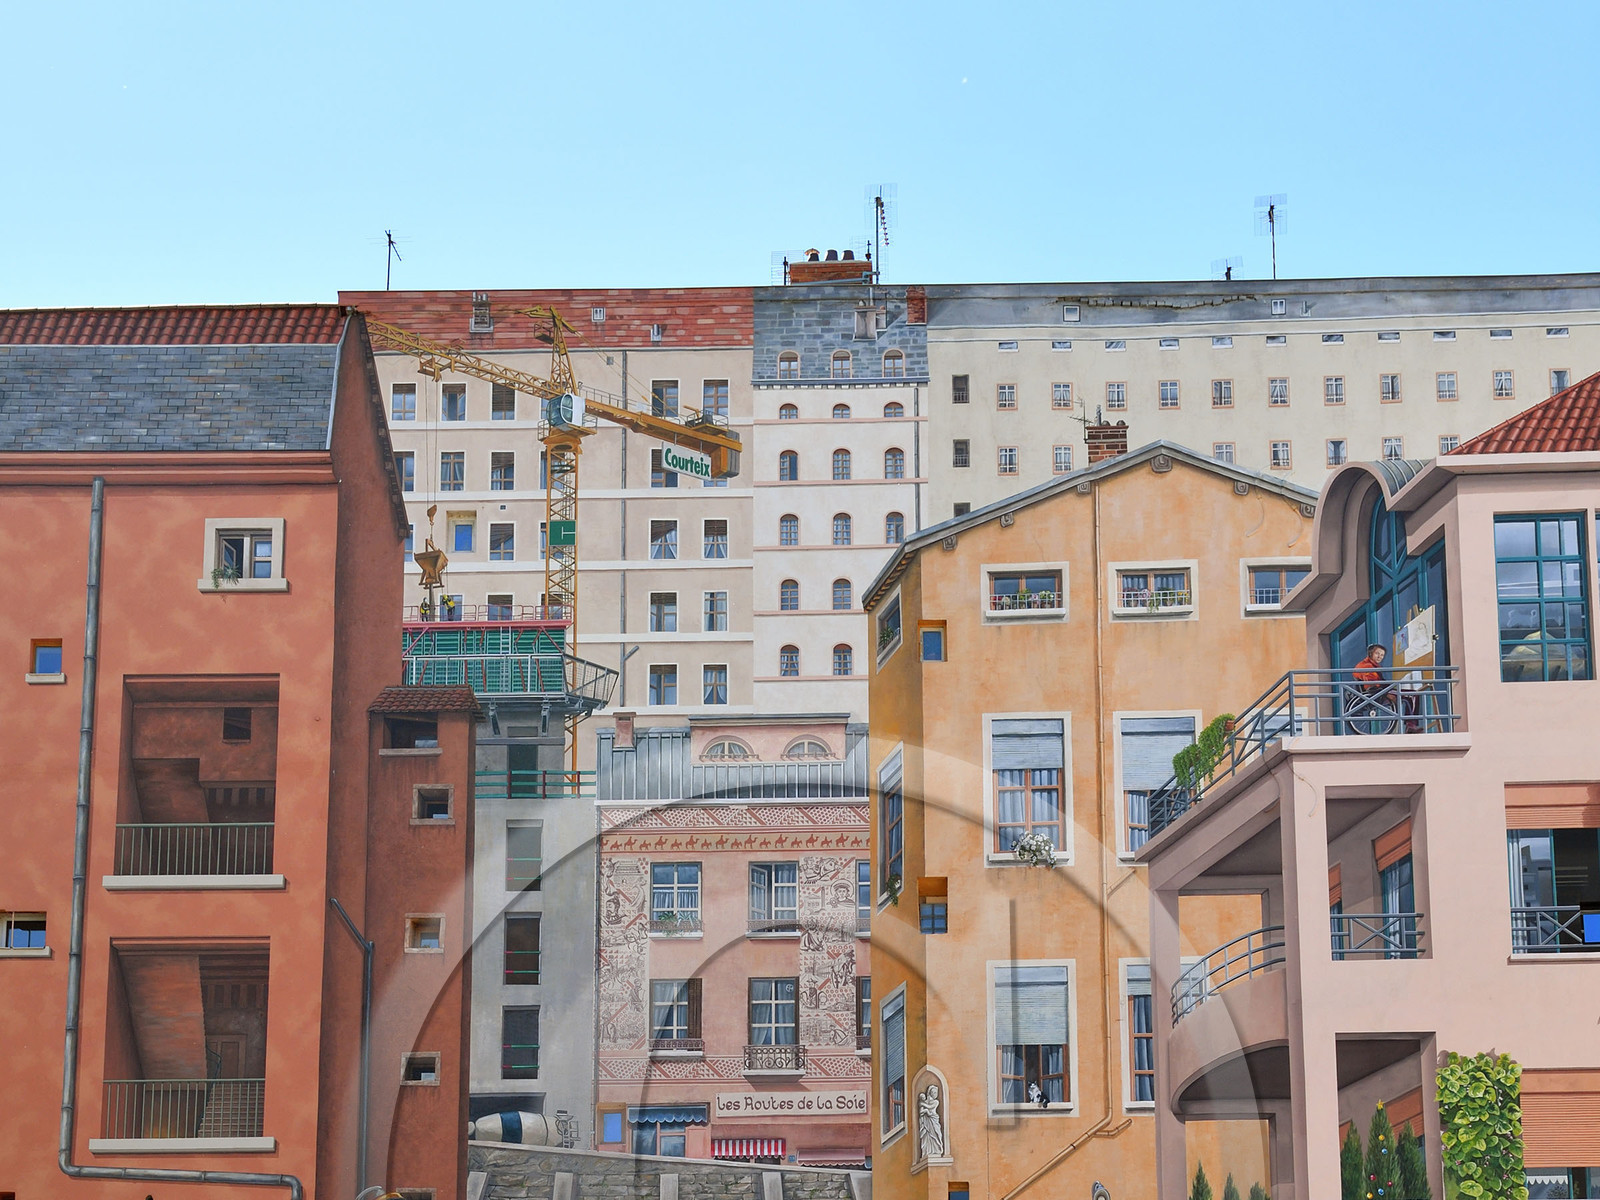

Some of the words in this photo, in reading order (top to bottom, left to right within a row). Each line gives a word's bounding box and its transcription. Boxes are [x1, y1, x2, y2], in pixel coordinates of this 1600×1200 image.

[664, 448, 710, 478] Courteix
[717, 1096, 741, 1110] Les
[744, 1096, 794, 1111] Routes
[797, 1096, 813, 1110] de
[836, 1094, 866, 1110] Soie
